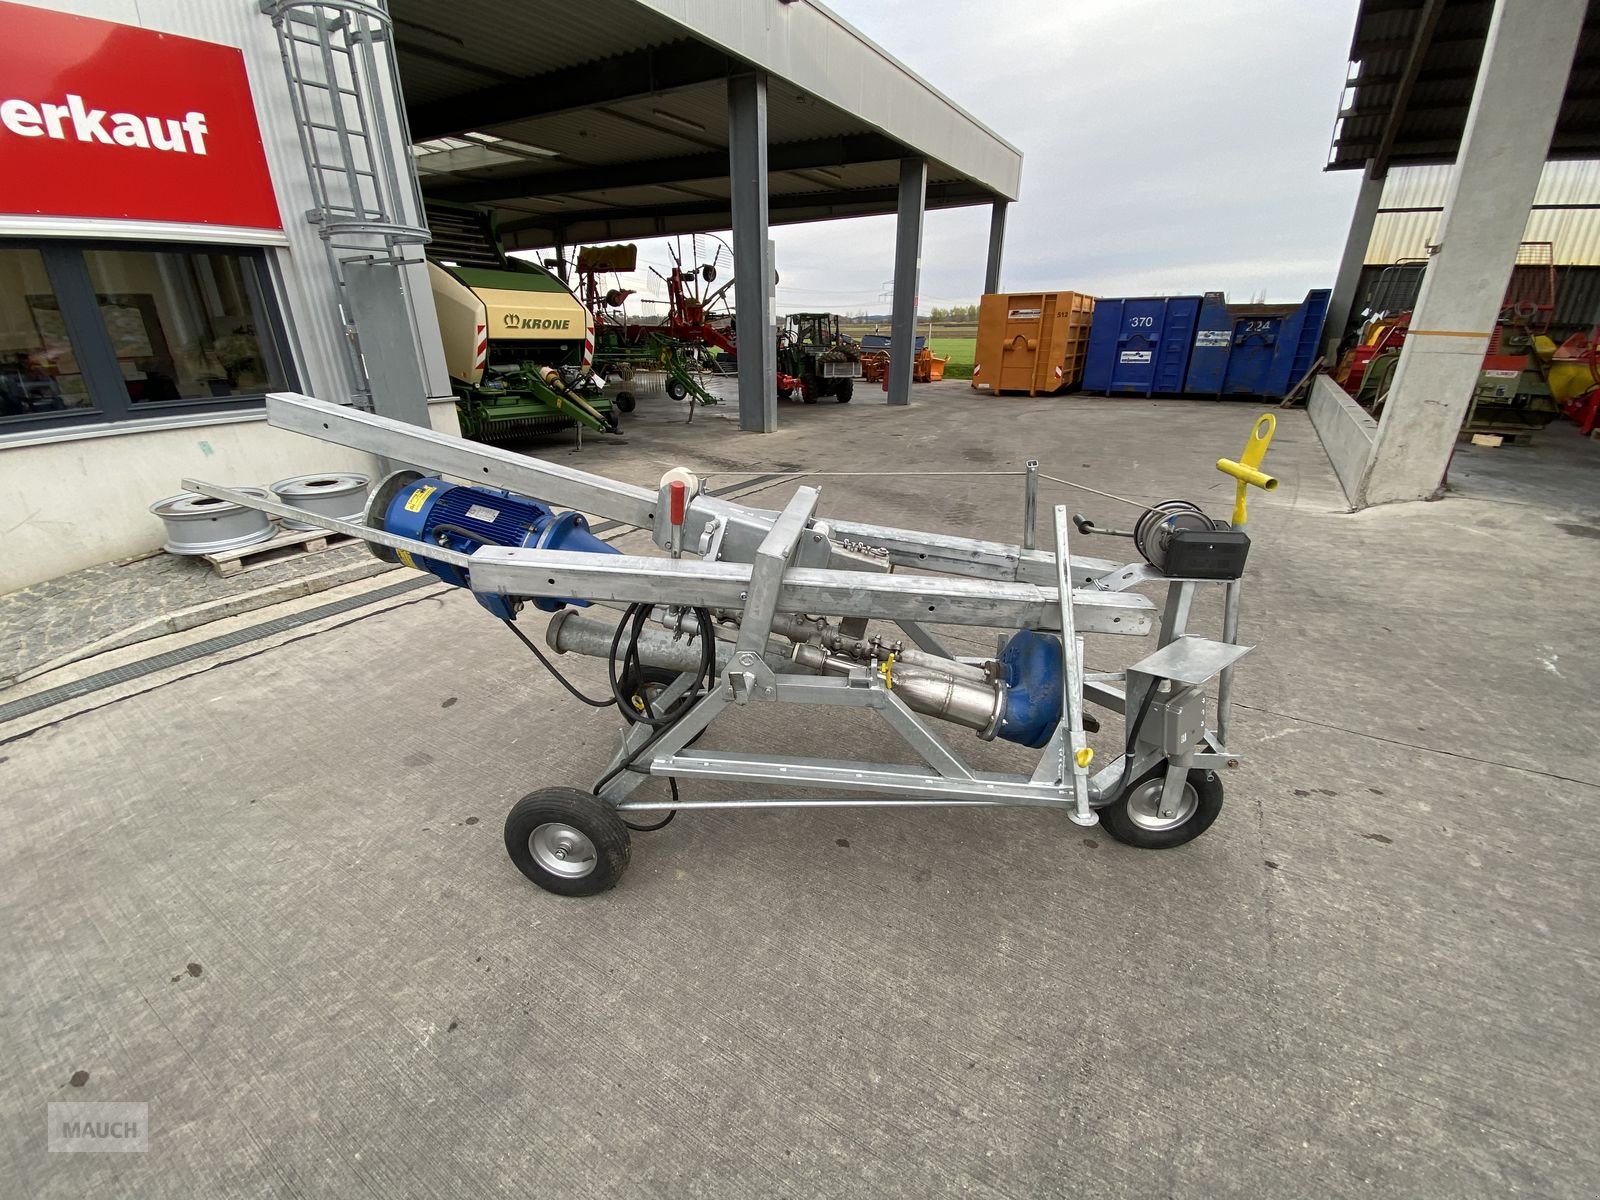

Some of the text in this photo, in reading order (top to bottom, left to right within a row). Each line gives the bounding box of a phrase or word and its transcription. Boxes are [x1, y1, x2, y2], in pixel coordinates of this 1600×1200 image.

[0, 94, 208, 156] erkauf
[521, 318, 570, 330] KRONE
[1131, 316, 1153, 327] 370
[1245, 320, 1271, 332] 224
